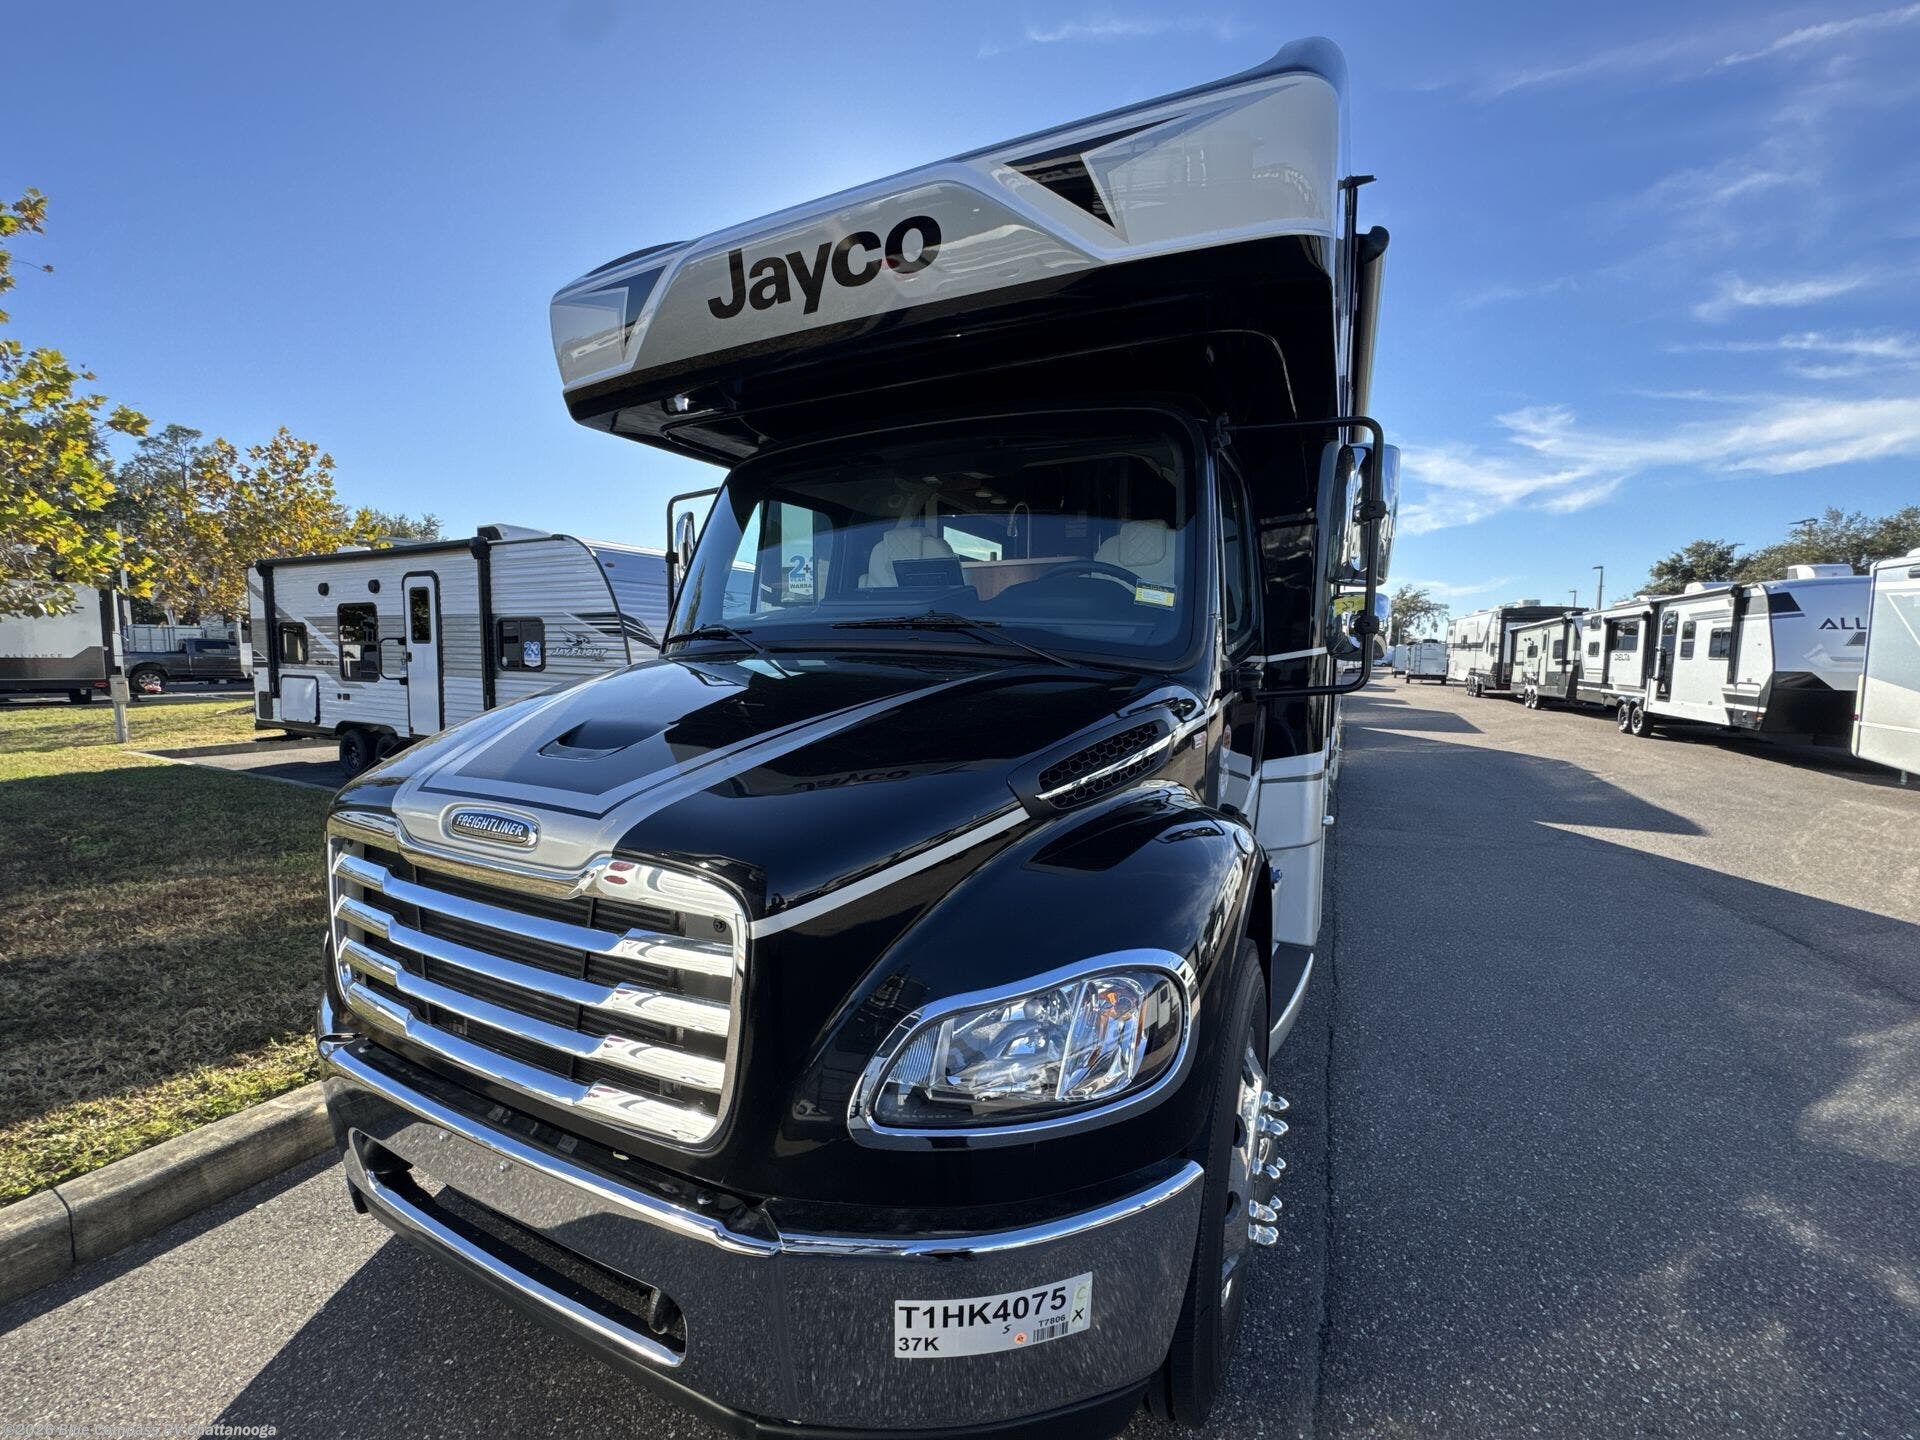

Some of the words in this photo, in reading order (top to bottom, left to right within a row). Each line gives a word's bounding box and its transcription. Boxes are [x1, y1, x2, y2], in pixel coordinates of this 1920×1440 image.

[707, 215, 942, 320] Jayco
[551, 647, 570, 657] JAY
[456, 814, 524, 836] FREIGHTLINER
[898, 1286, 1066, 1329] T1HK4075
[1038, 1314, 1066, 1328] T7806
[898, 1337, 940, 1352] 37K
